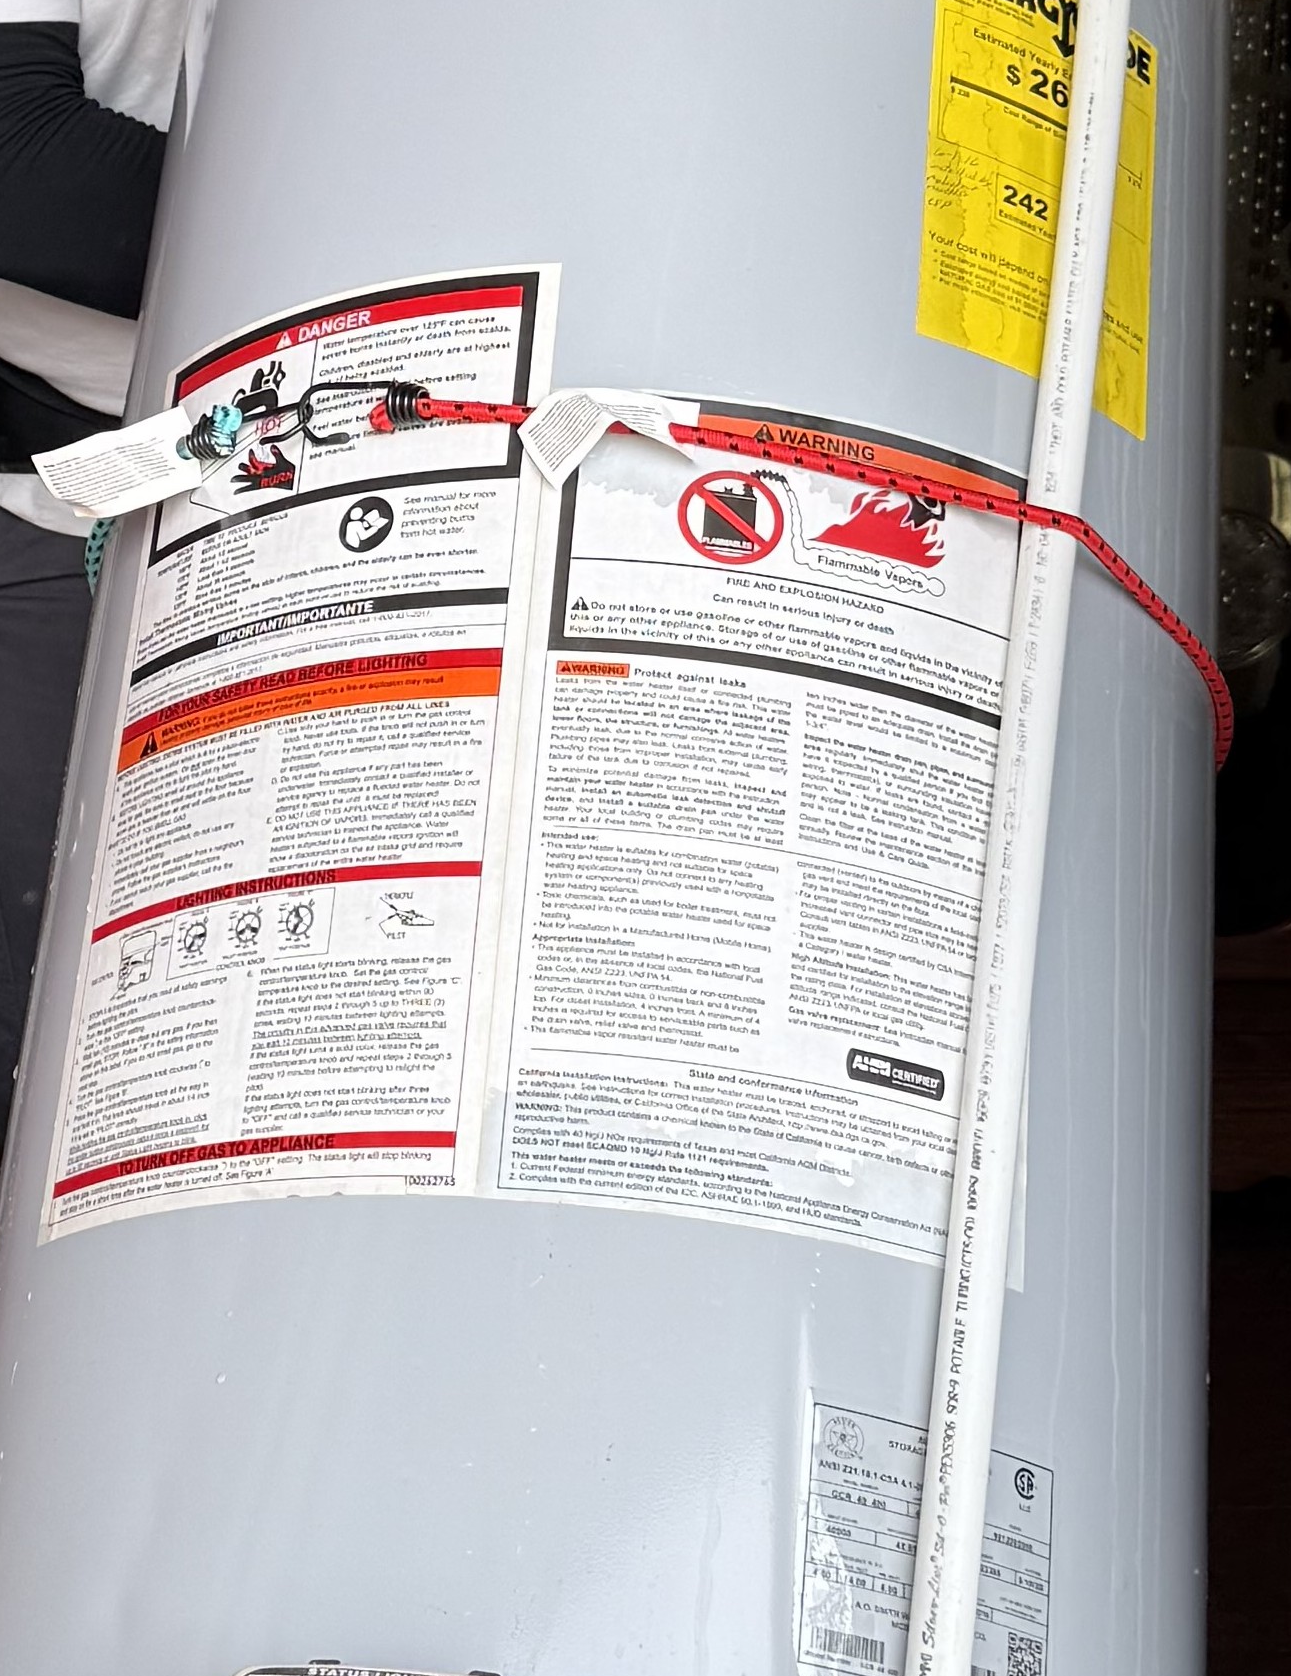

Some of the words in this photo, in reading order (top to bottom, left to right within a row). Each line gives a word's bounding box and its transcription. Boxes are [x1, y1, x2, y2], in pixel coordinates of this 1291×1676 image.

[1006, 64, 1021, 87] $
[1030, 68, 1069, 108] 26
[1003, 184, 1049, 221] 242
[298, 310, 371, 342] DANGER
[779, 428, 875, 461] WARNING
[885, 569, 923, 588] Vapors
[713, 594, 734, 604] Can
[216, 599, 374, 646] IMPORTANT/IMPORTANTE
[212, 680, 258, 709] SAFETY
[260, 668, 296, 690] READ
[297, 662, 355, 684] BEFORE
[357, 654, 428, 675] LIGHTING
[634, 668, 672, 679] Protect
[677, 672, 714, 685] against
[719, 676, 746, 688] leaks
[176, 886, 234, 910] LIGHTING
[236, 869, 337, 896] INSTRUCTIONS
[135, 1154, 167, 1172] TURN
[170, 1149, 196, 1166] OFF
[197, 1145, 226, 1161] GAS
[228, 1141, 247, 1157] TO
[250, 1134, 335, 1154] APPLIANCE
